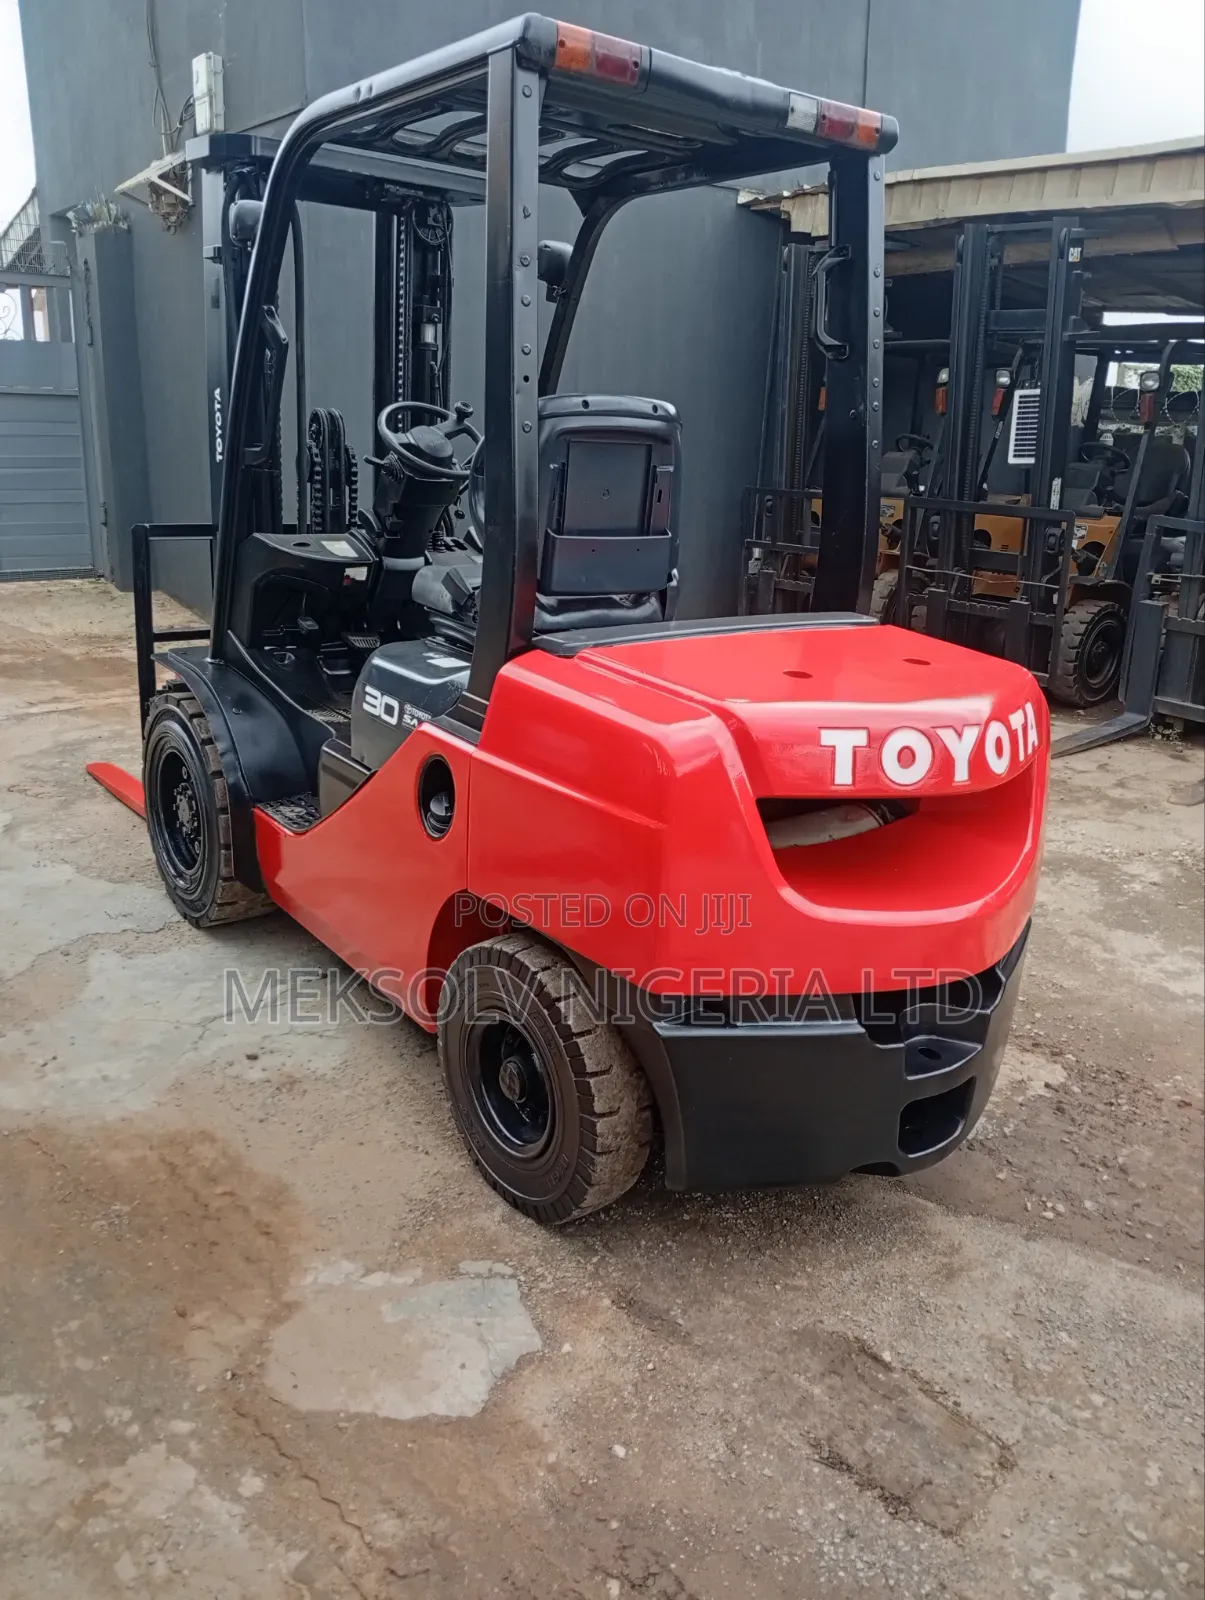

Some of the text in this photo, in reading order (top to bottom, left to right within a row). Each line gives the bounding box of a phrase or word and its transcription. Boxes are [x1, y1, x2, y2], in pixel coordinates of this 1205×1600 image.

[214, 387, 223, 463] TOYOTA
[362, 685, 399, 726] 30
[820, 701, 1039, 787] TOYOTA
